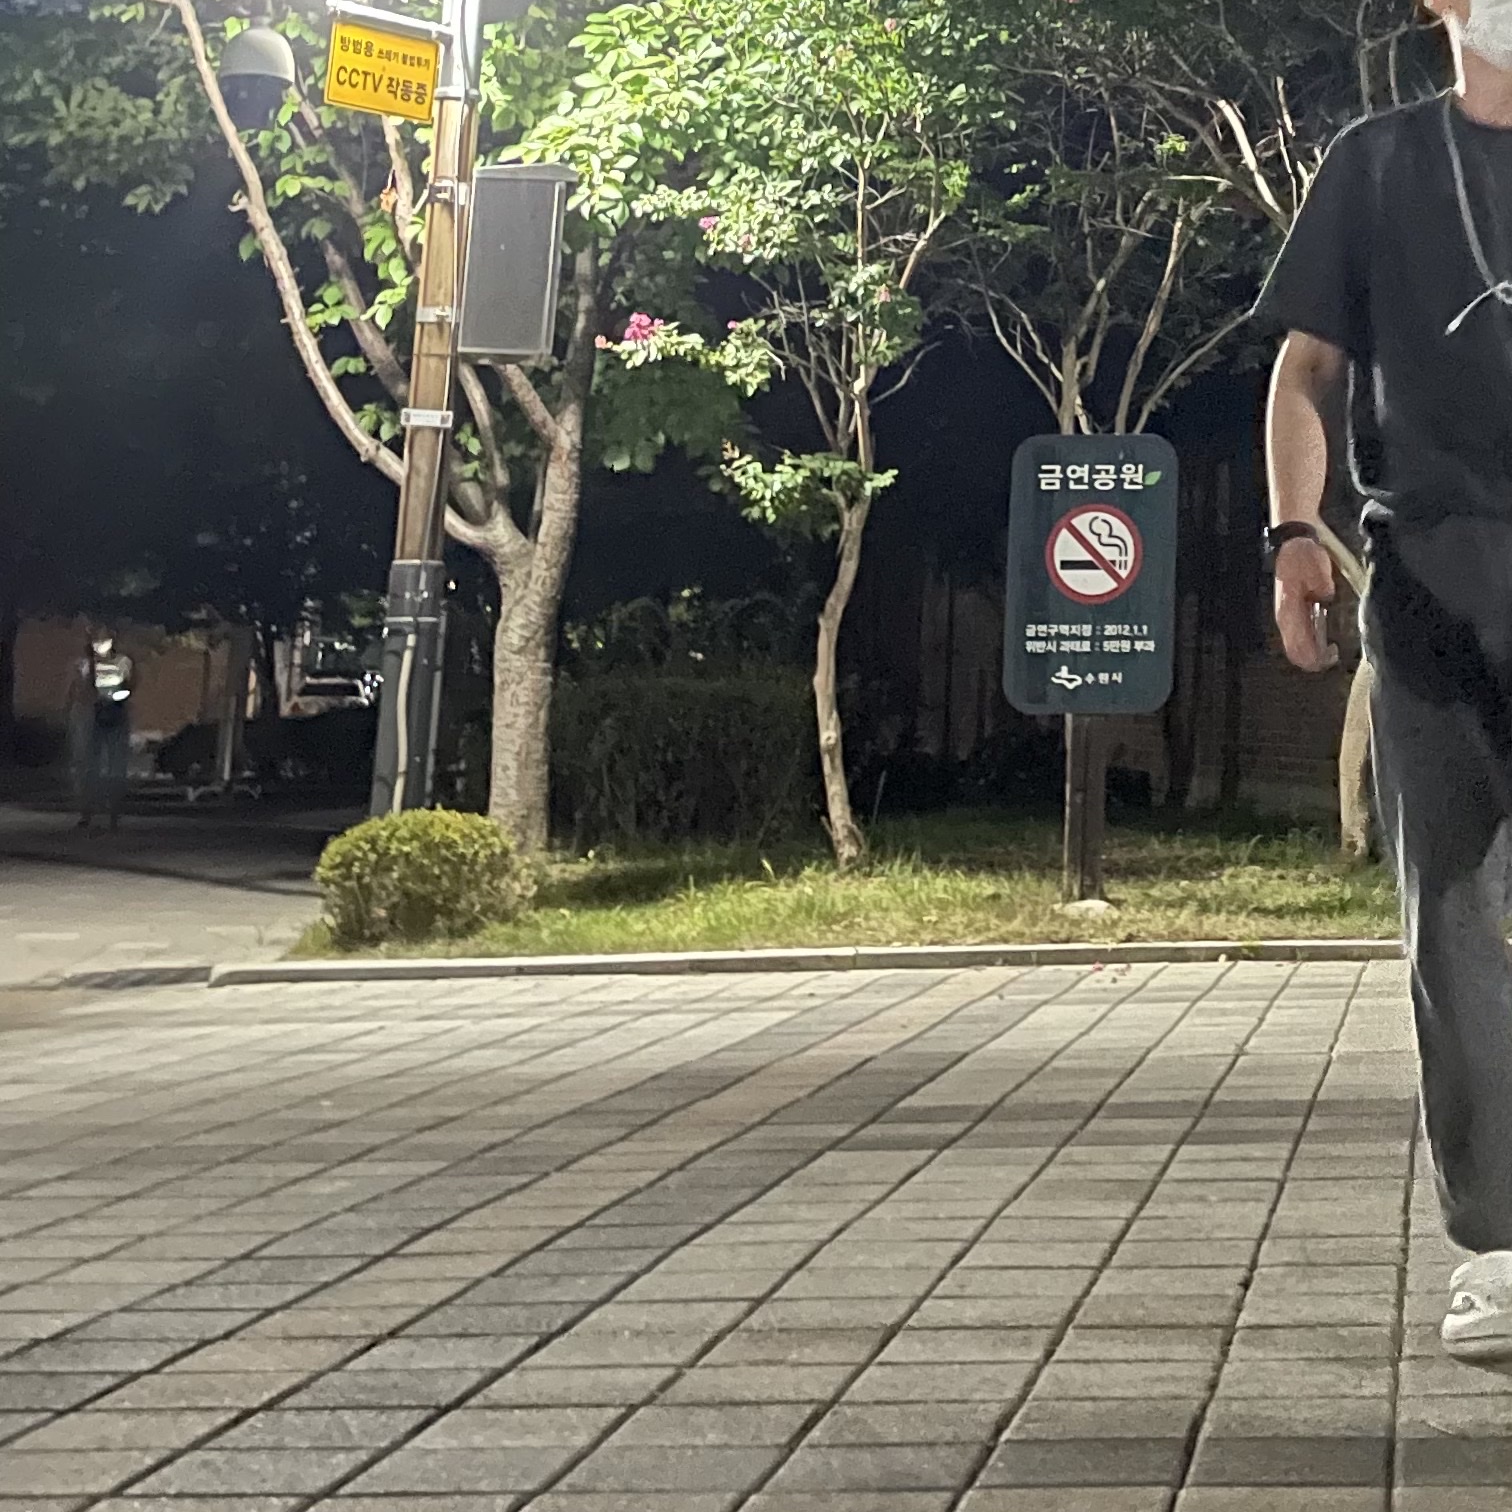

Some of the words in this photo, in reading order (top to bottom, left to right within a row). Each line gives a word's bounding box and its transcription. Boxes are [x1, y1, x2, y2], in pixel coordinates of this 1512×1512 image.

[340, 35, 374, 58] 방범용
[336, 65, 384, 93] CCTV
[386, 76, 428, 105] 작동중
[1037, 463, 1145, 491] 금연공원
[1025, 624, 1093, 637] 금연구역지정
[1084, 671, 1124, 685] 수원시
